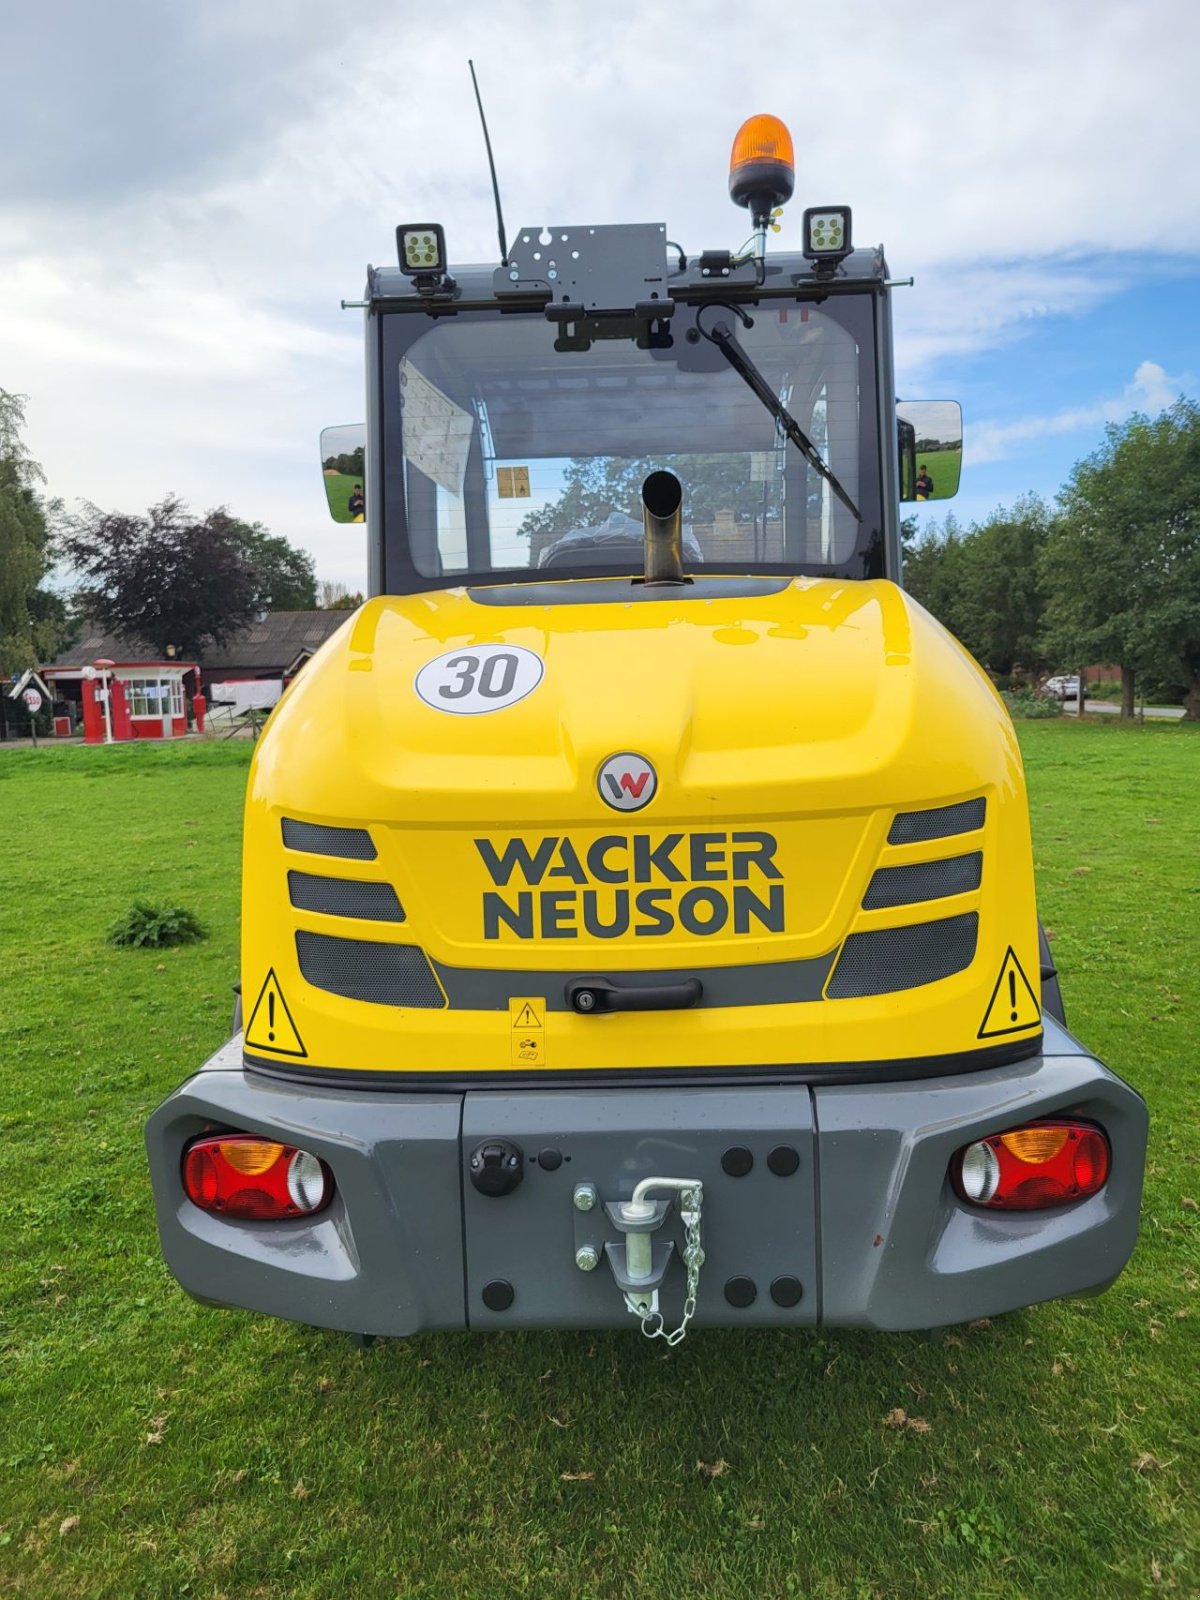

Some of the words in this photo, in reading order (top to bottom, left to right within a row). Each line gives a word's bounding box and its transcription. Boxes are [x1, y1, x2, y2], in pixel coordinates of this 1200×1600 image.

[438, 654, 519, 699] 30
[473, 831, 785, 886] WACKER
[482, 885, 785, 940] NEUSON
